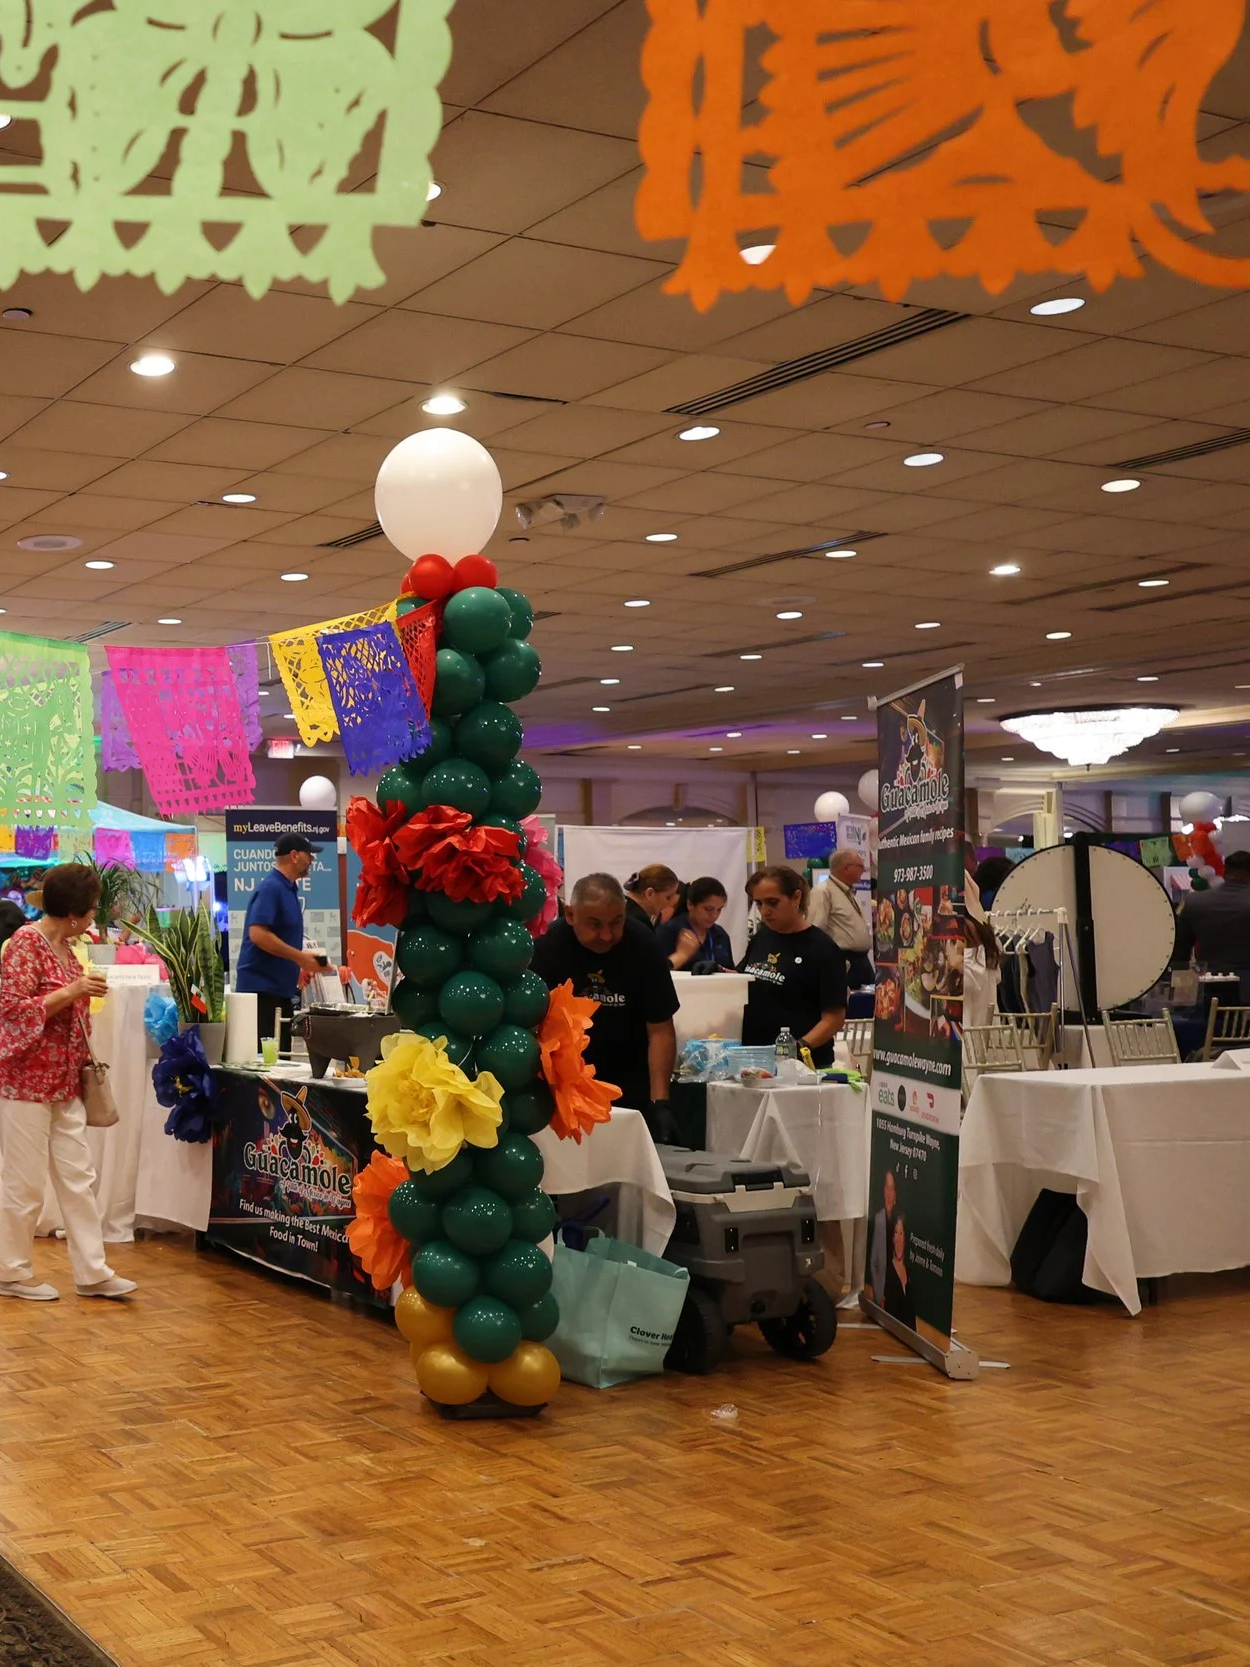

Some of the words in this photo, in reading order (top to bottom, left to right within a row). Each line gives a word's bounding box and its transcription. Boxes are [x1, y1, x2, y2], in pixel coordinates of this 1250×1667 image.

[880, 773, 950, 813] Guacamole
[234, 821, 330, 834] myLeaveBenefits.nj.gov
[934, 826, 954, 842] recipes
[894, 864, 934, 883] 973-987-3500
[234, 878, 255, 892] NJ
[244, 1142, 352, 1196] Guacamole
[239, 1198, 254, 1213] Find
[255, 1206, 263, 1216] us
[264, 1208, 290, 1227] making
[291, 1215, 304, 1228] the
[305, 1220, 320, 1234] Best
[321, 1224, 350, 1243] Mexica
[270, 1226, 288, 1241] Food
[289, 1233, 295, 1244] in
[297, 1234, 318, 1252] Town!
[630, 1326, 661, 1340] Clover
